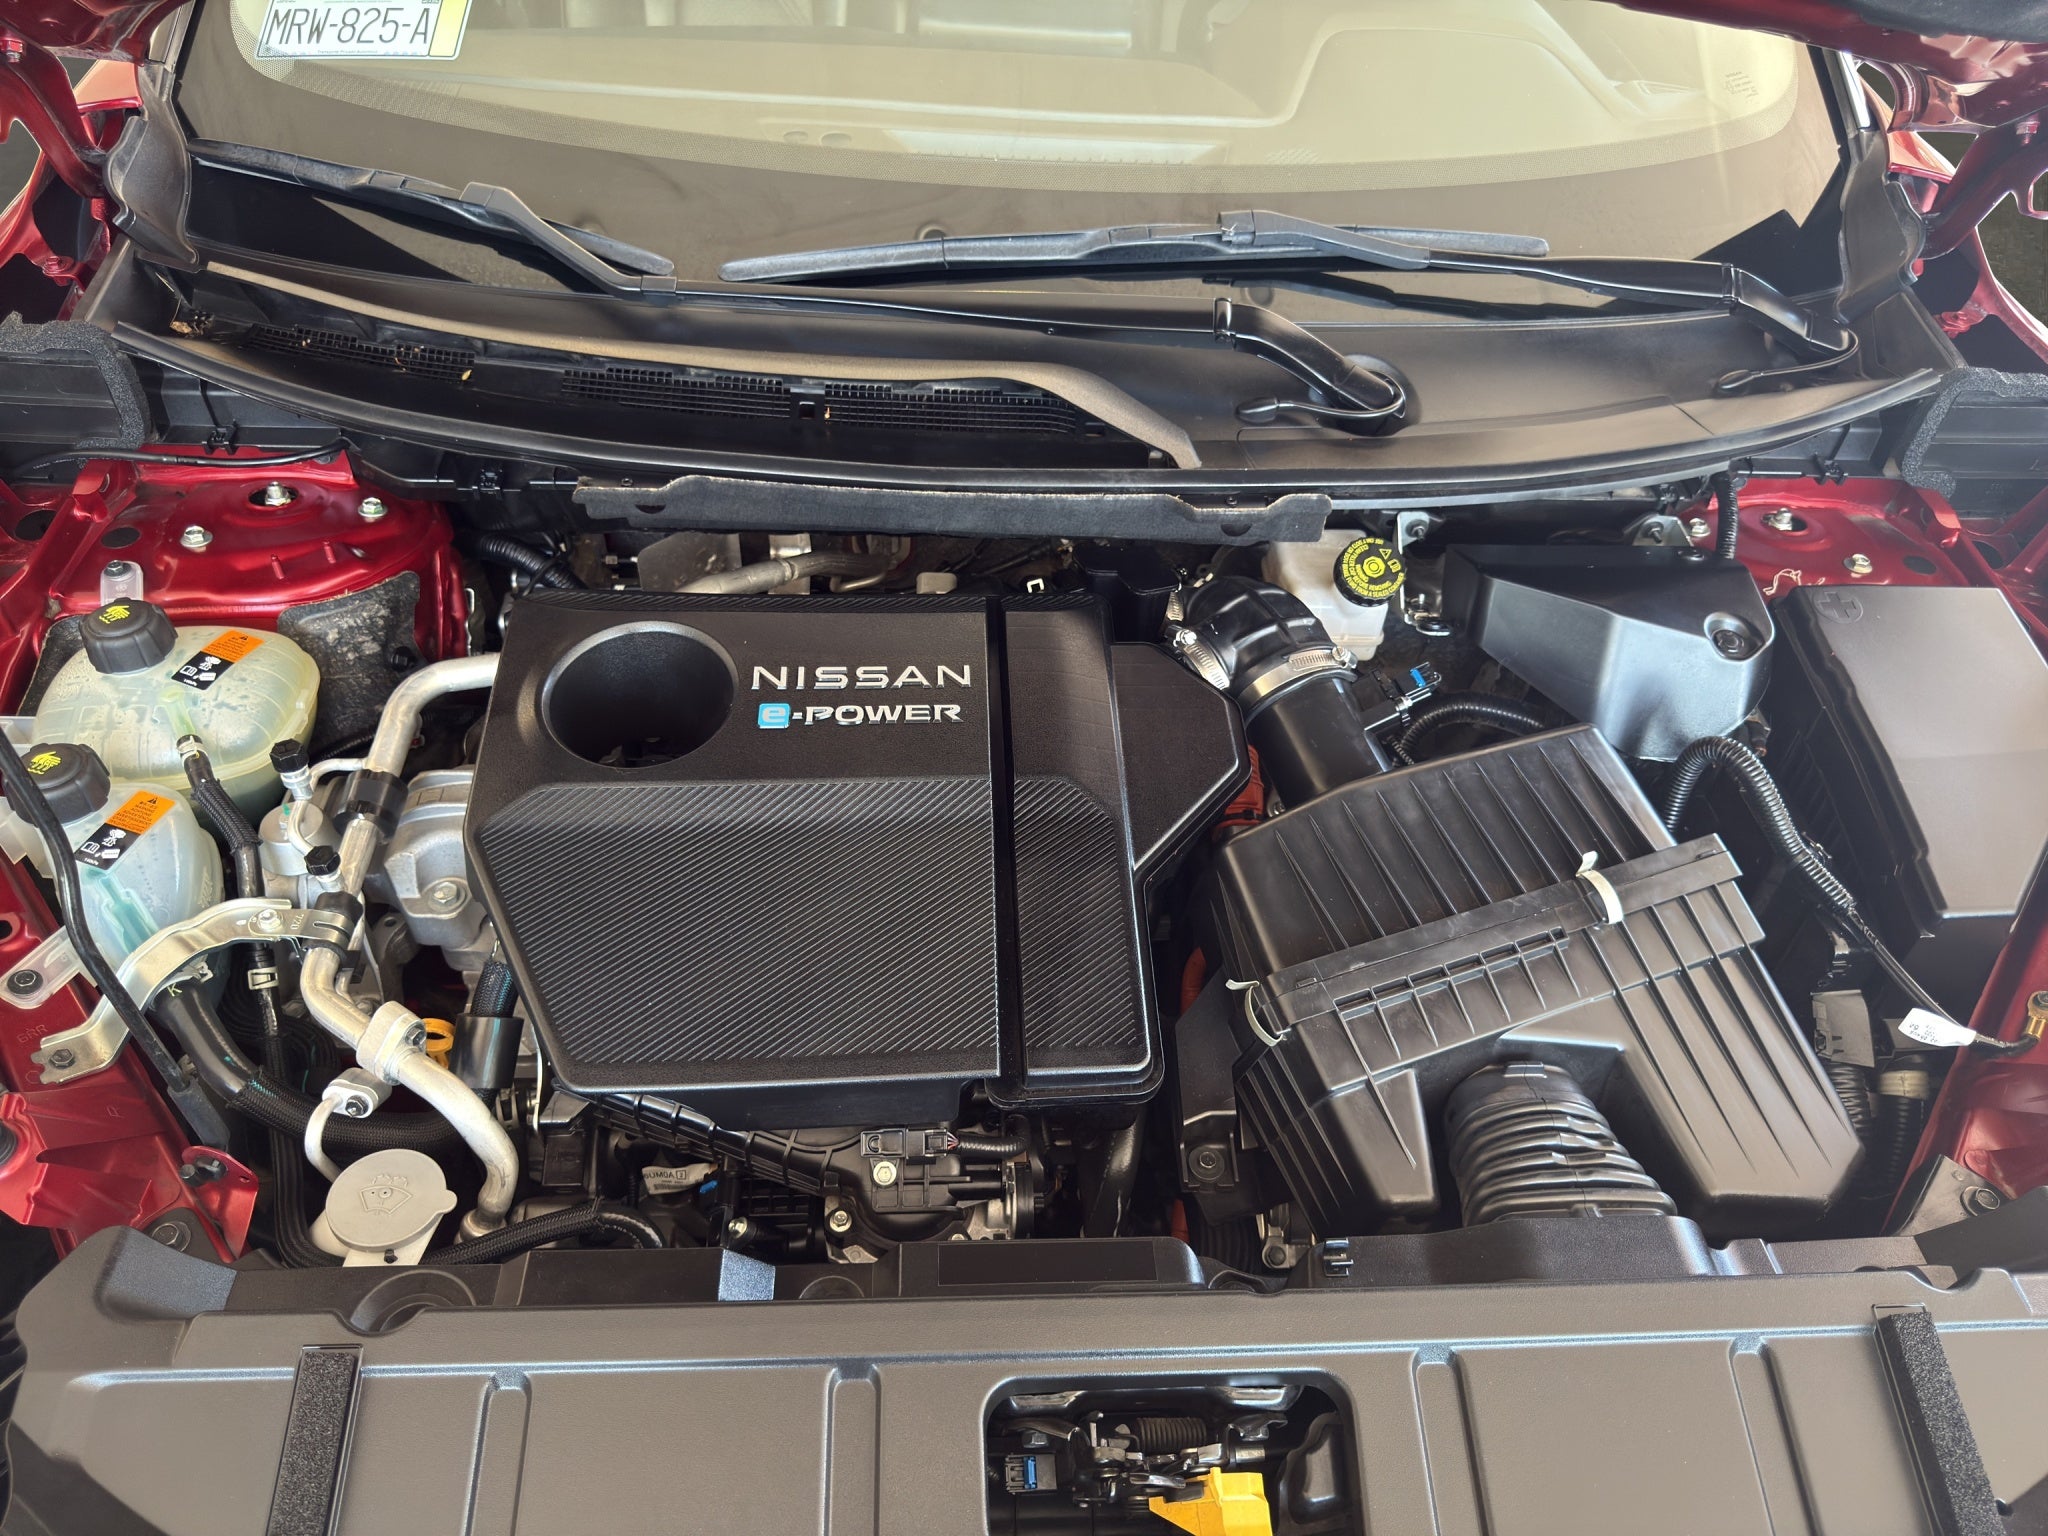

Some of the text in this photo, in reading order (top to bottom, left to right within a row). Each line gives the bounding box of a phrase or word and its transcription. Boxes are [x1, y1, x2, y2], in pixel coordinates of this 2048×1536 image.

[265, 7, 430, 44] MRW-825-A
[751, 664, 972, 690] NISSAN
[758, 703, 963, 729] e-POWER
